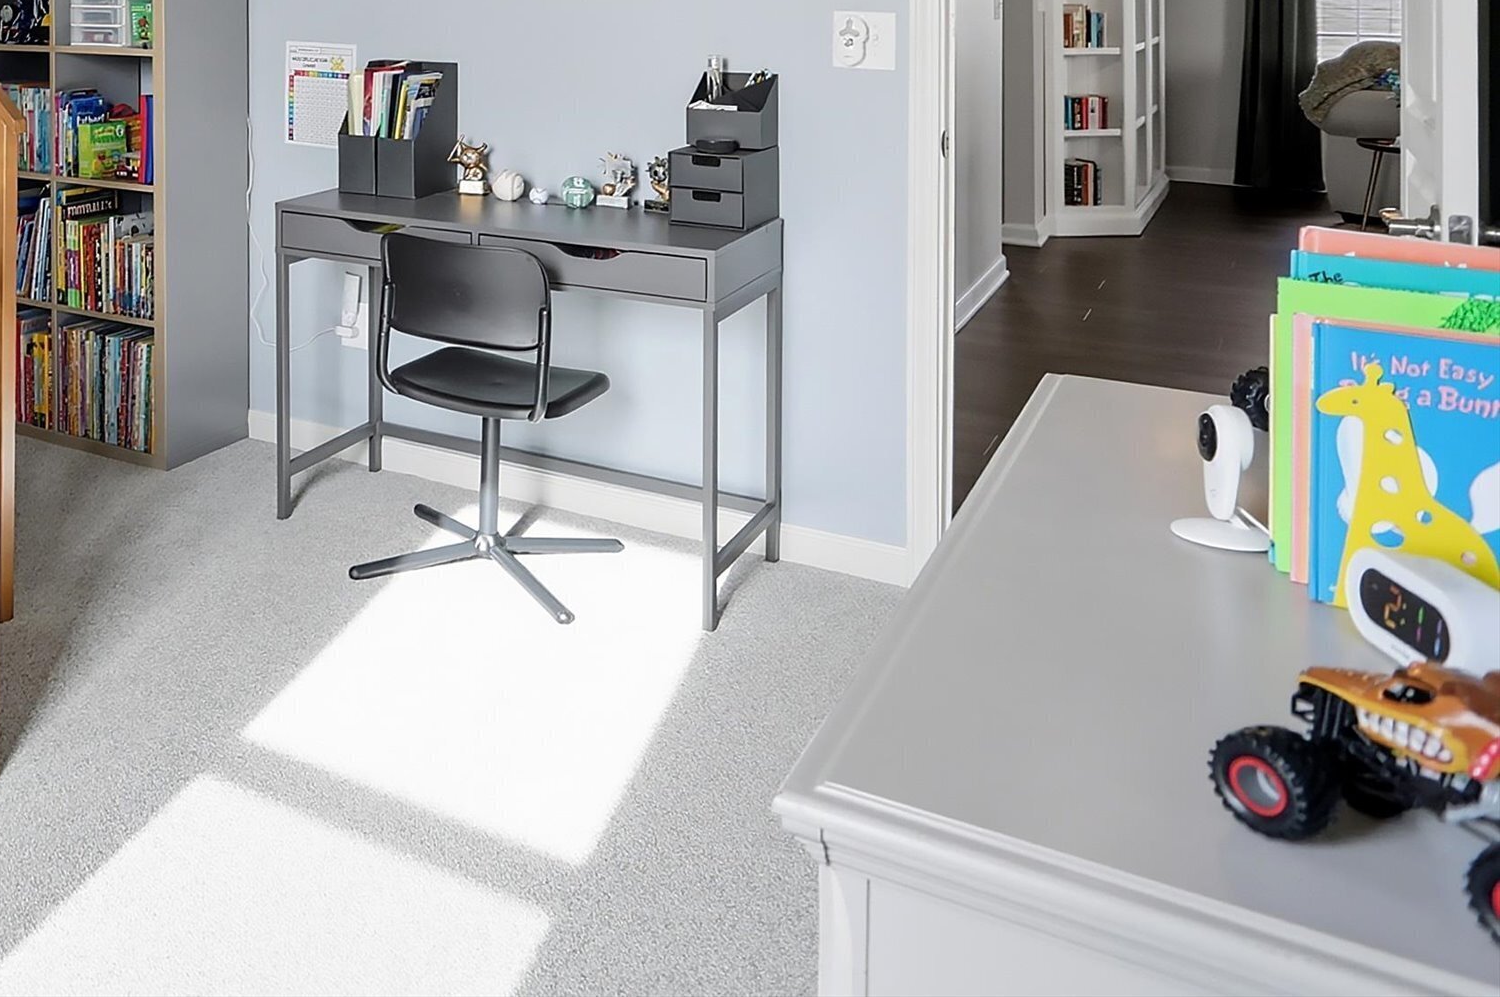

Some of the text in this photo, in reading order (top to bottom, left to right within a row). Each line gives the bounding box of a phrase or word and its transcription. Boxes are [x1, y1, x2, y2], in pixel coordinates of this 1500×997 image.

[1351, 351, 1495, 391] It' Not Easy
[1416, 389, 1432, 407] a
